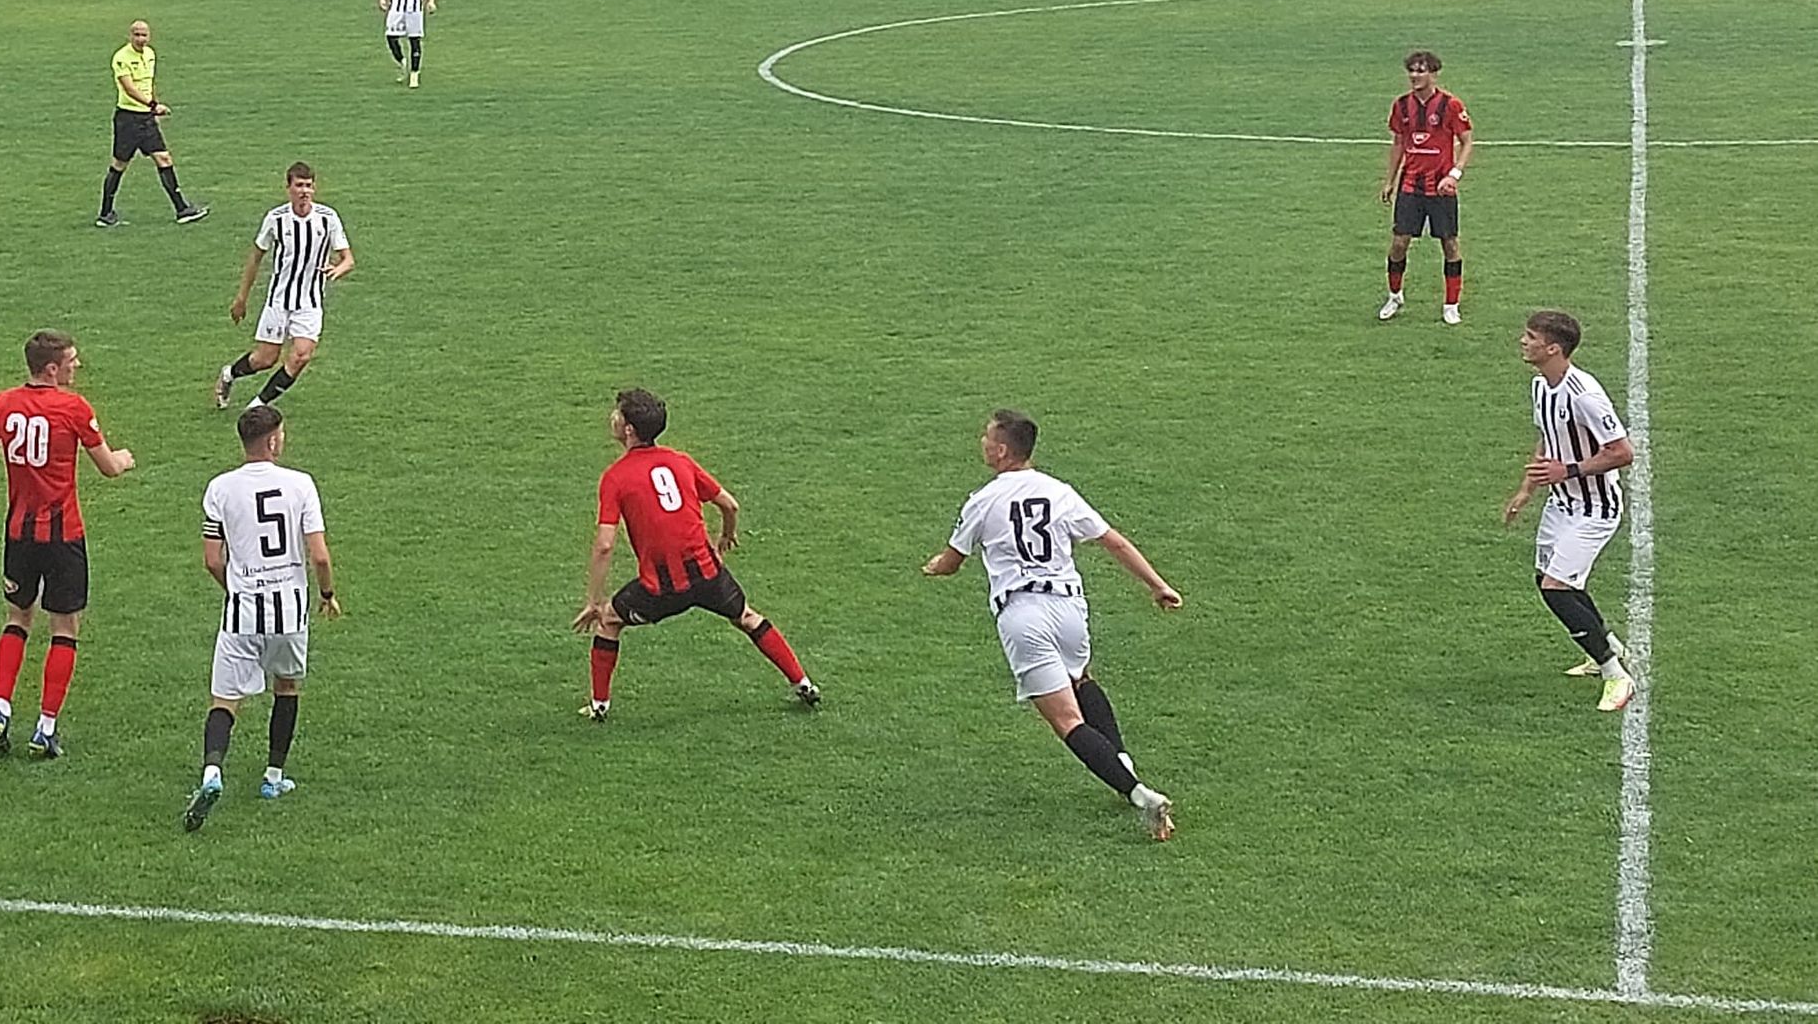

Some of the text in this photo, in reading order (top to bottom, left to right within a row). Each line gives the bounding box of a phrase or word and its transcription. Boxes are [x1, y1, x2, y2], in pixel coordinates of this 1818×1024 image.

[5, 412, 50, 468] 20
[650, 466, 683, 512] 9
[255, 488, 287, 558] 5
[1009, 497, 1052, 564] 13
